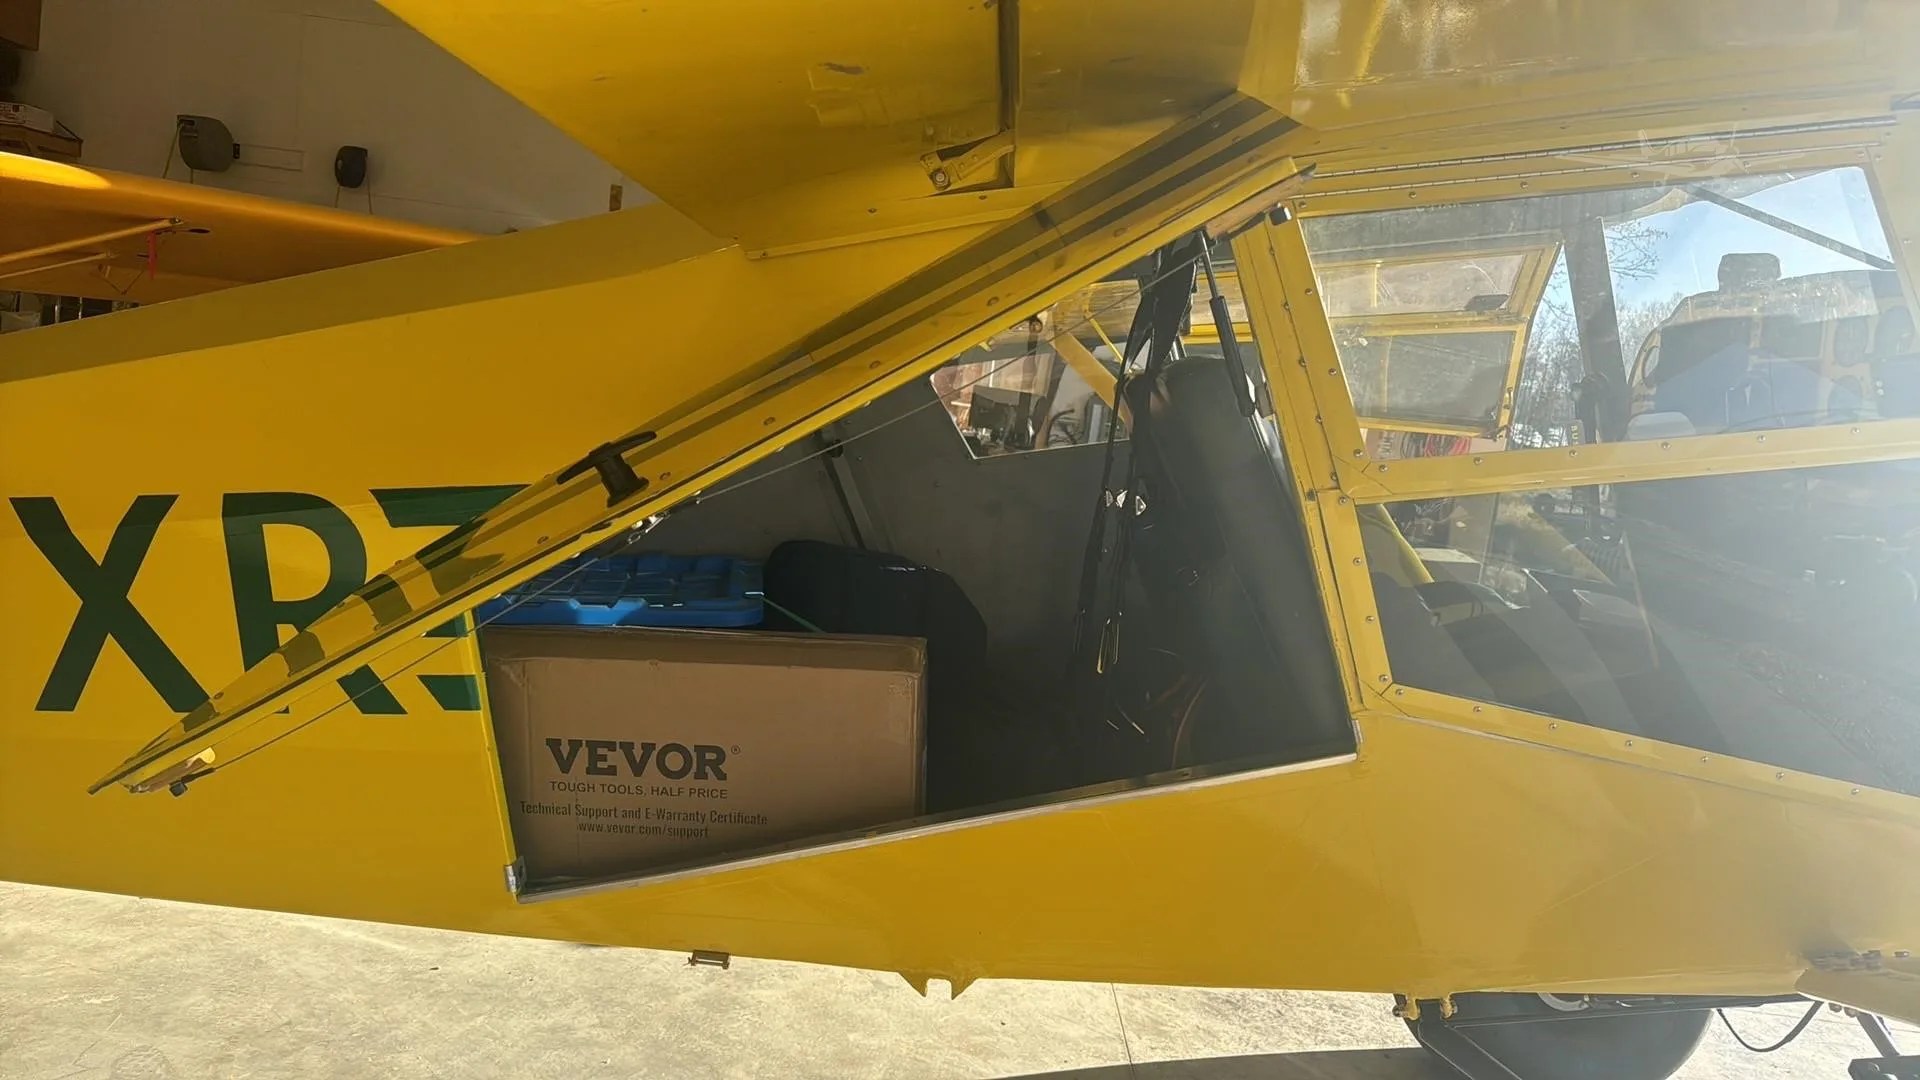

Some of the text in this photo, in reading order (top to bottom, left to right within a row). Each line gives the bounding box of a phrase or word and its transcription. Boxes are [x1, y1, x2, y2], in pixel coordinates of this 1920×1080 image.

[550, 781, 596, 793] TOUGH
[651, 786, 685, 797] HALF
[688, 787, 728, 799] PRICE
[520, 800, 768, 825] Technical Support and E-Warranty Certificate
[577, 822, 709, 840] www.vevor.com/support
